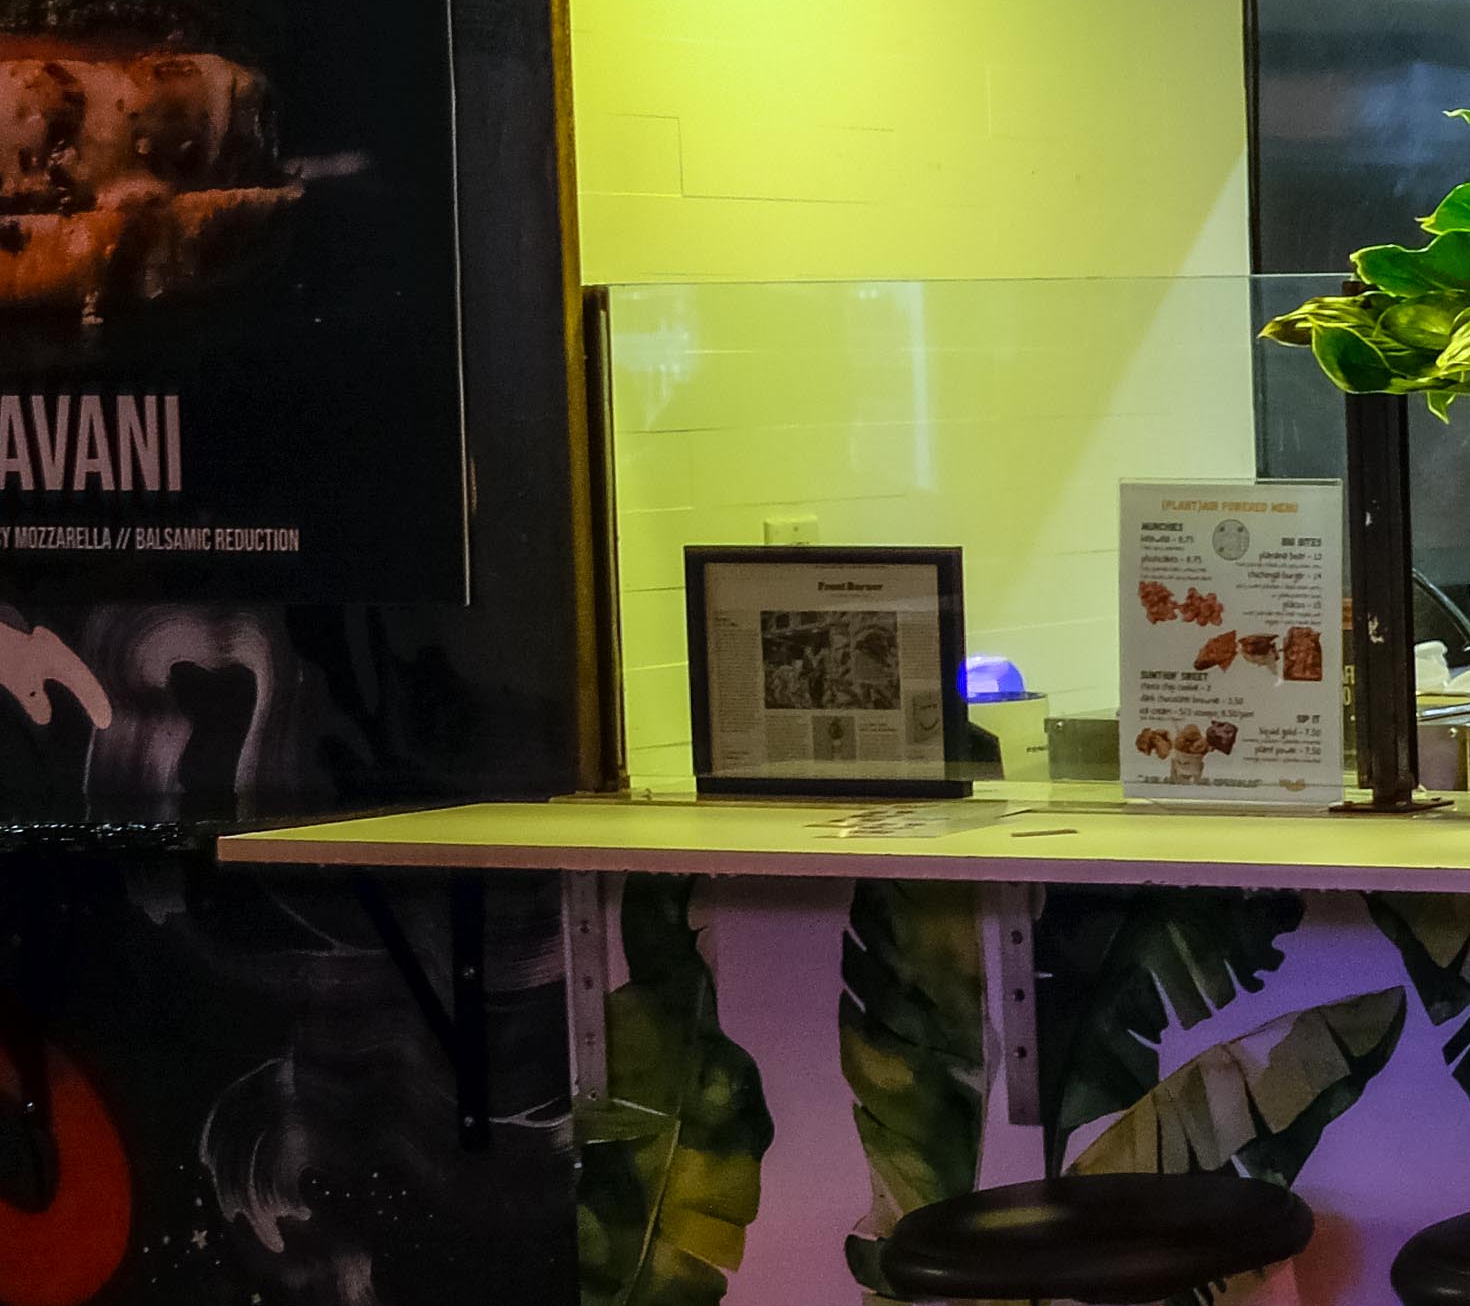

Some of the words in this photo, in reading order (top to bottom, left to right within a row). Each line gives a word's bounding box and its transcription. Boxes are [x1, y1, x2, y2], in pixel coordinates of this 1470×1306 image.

[15, 527, 111, 550] MOZZARELLA
[135, 527, 213, 550] BALSAMIC
[215, 528, 300, 552] REDUCTION
